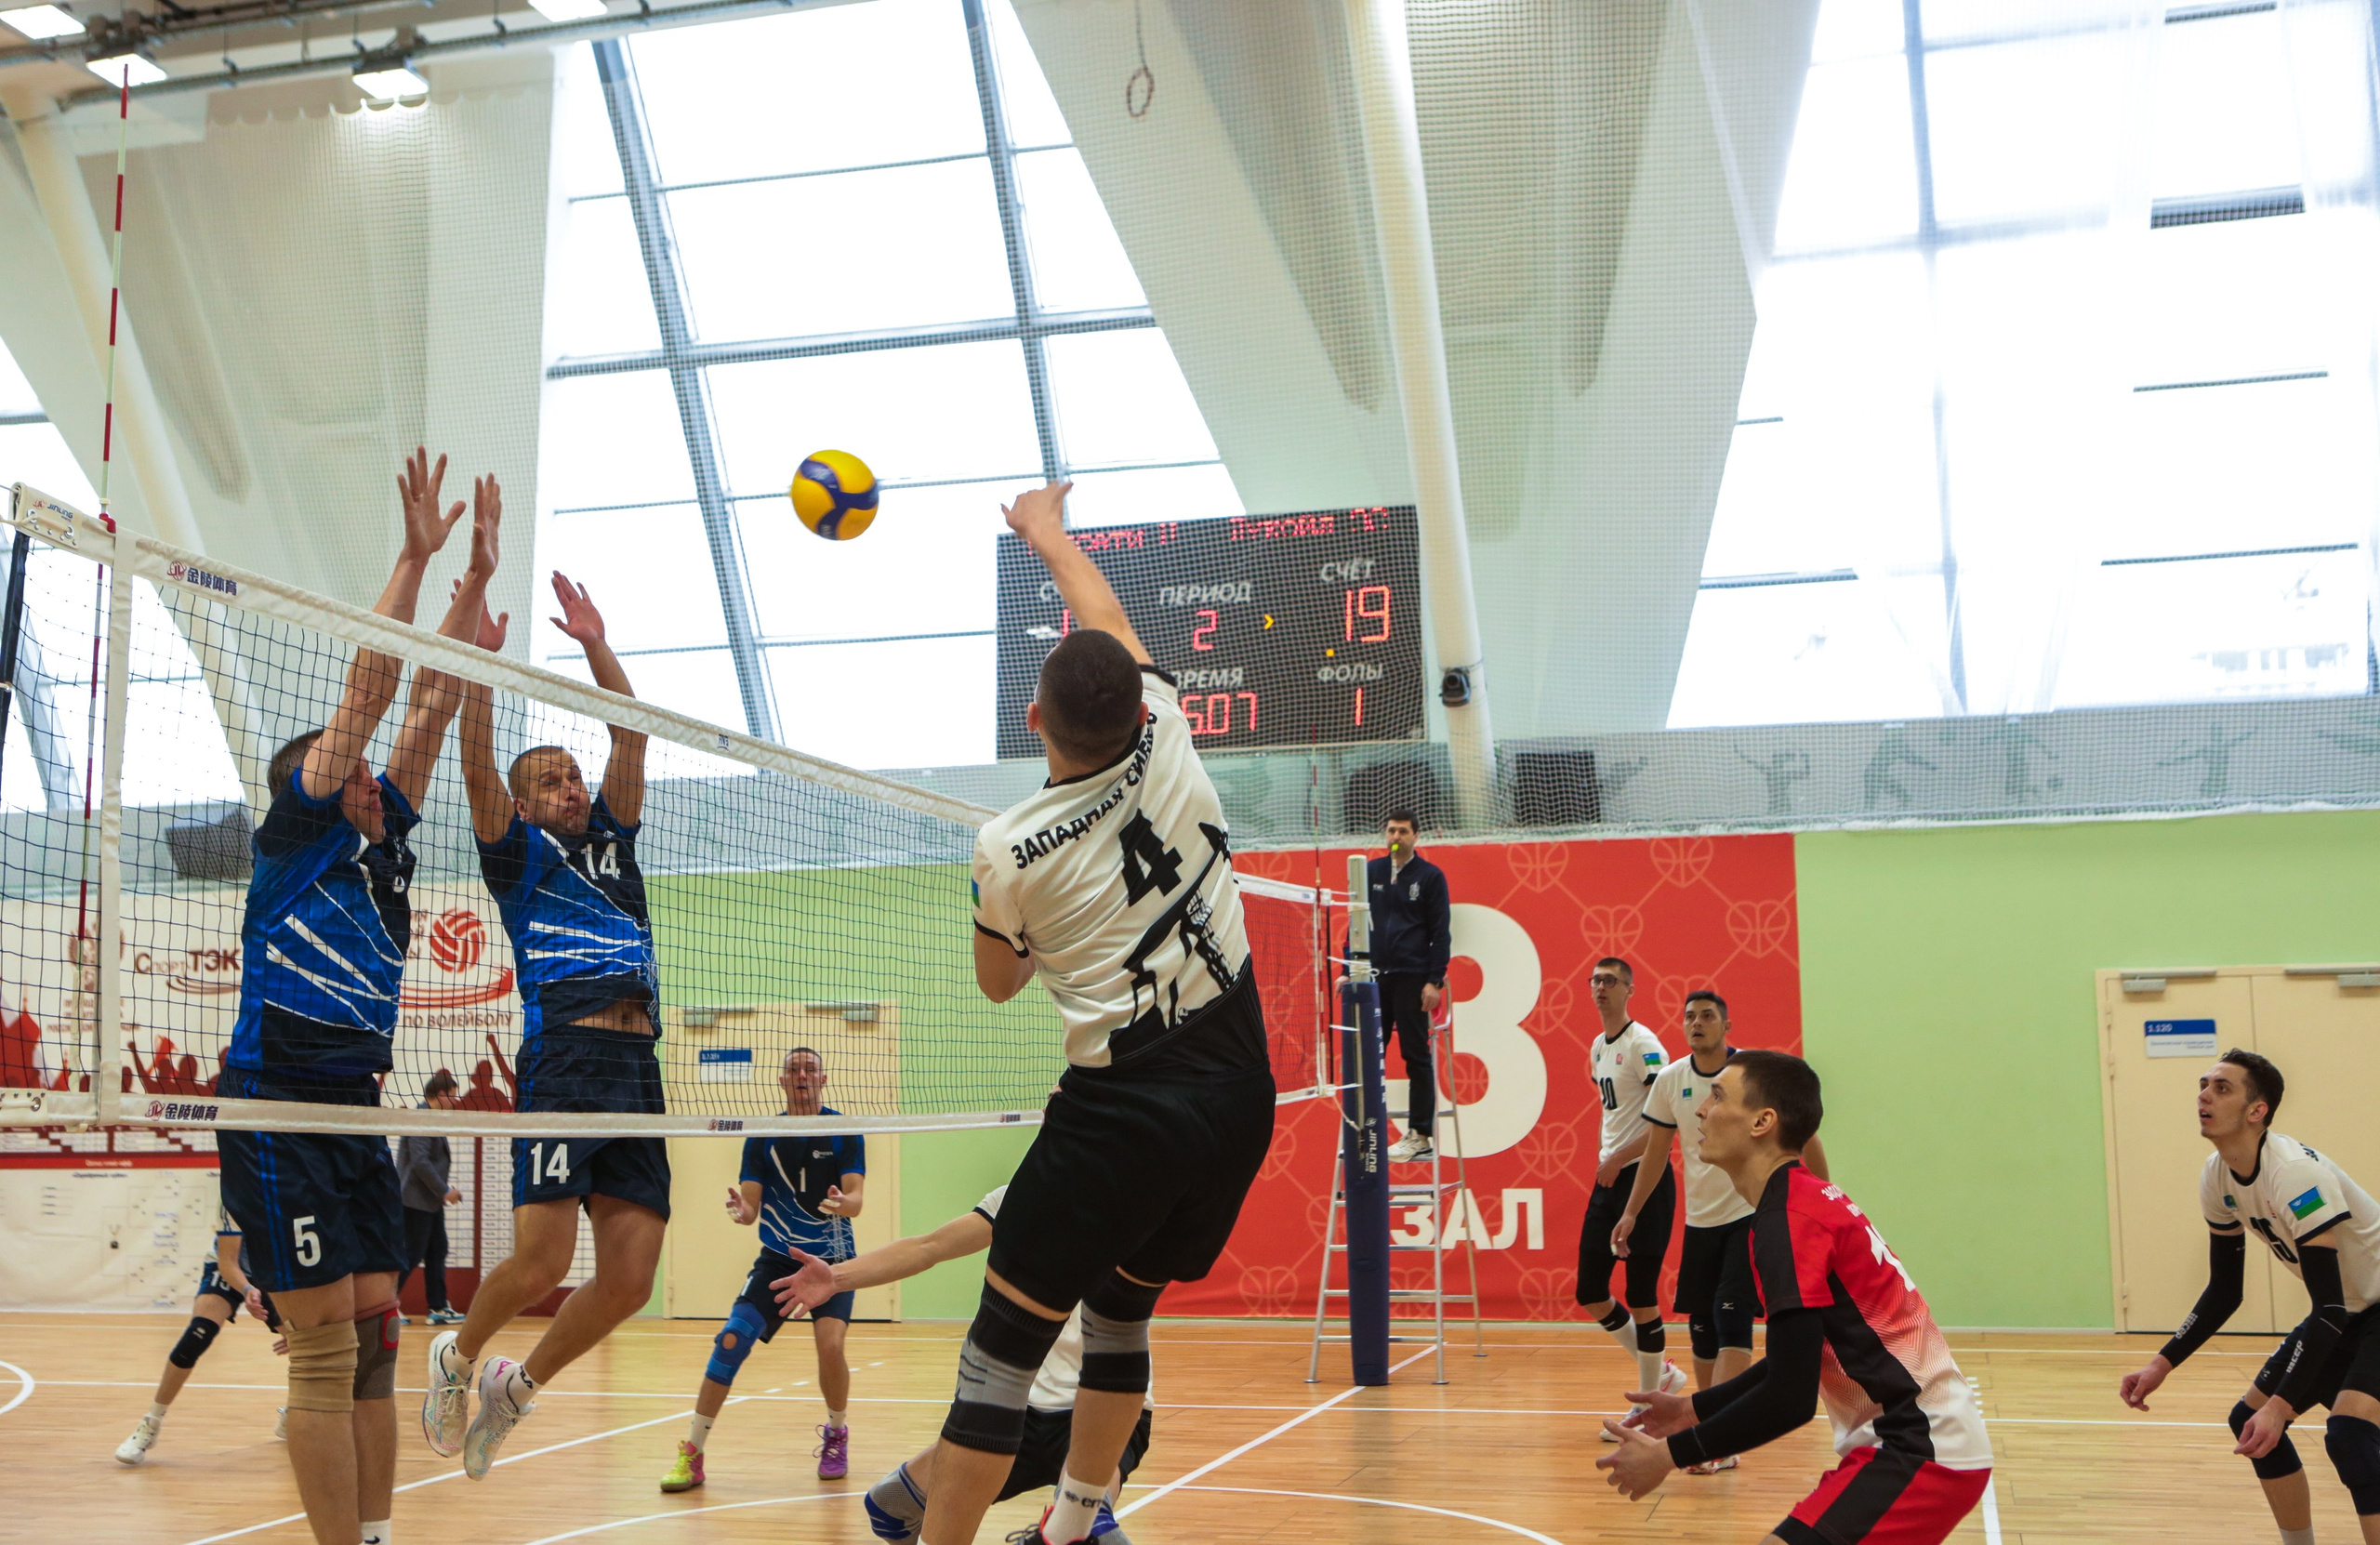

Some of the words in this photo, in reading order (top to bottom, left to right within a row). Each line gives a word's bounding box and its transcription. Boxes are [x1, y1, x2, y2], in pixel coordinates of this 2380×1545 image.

[187, 566, 238, 597] 金陵体育
[1159, 582, 1251, 605] ПЕРИОД
[1193, 609, 1218, 651] 2
[1345, 585, 1391, 642] 19
[1317, 663, 1383, 682] ФОЛЫ
[1355, 687, 1362, 726] 1
[1125, 712, 1157, 786] СИБЬ
[580, 842, 621, 880] 14
[1118, 808, 1183, 907] 4
[165, 1103, 219, 1121] 金陵体育
[530, 1142, 571, 1186] 14
[799, 1167, 806, 1193] 1
[1389, 1188, 1545, 1250] ЗАЛ
[293, 1214, 322, 1267] 5
